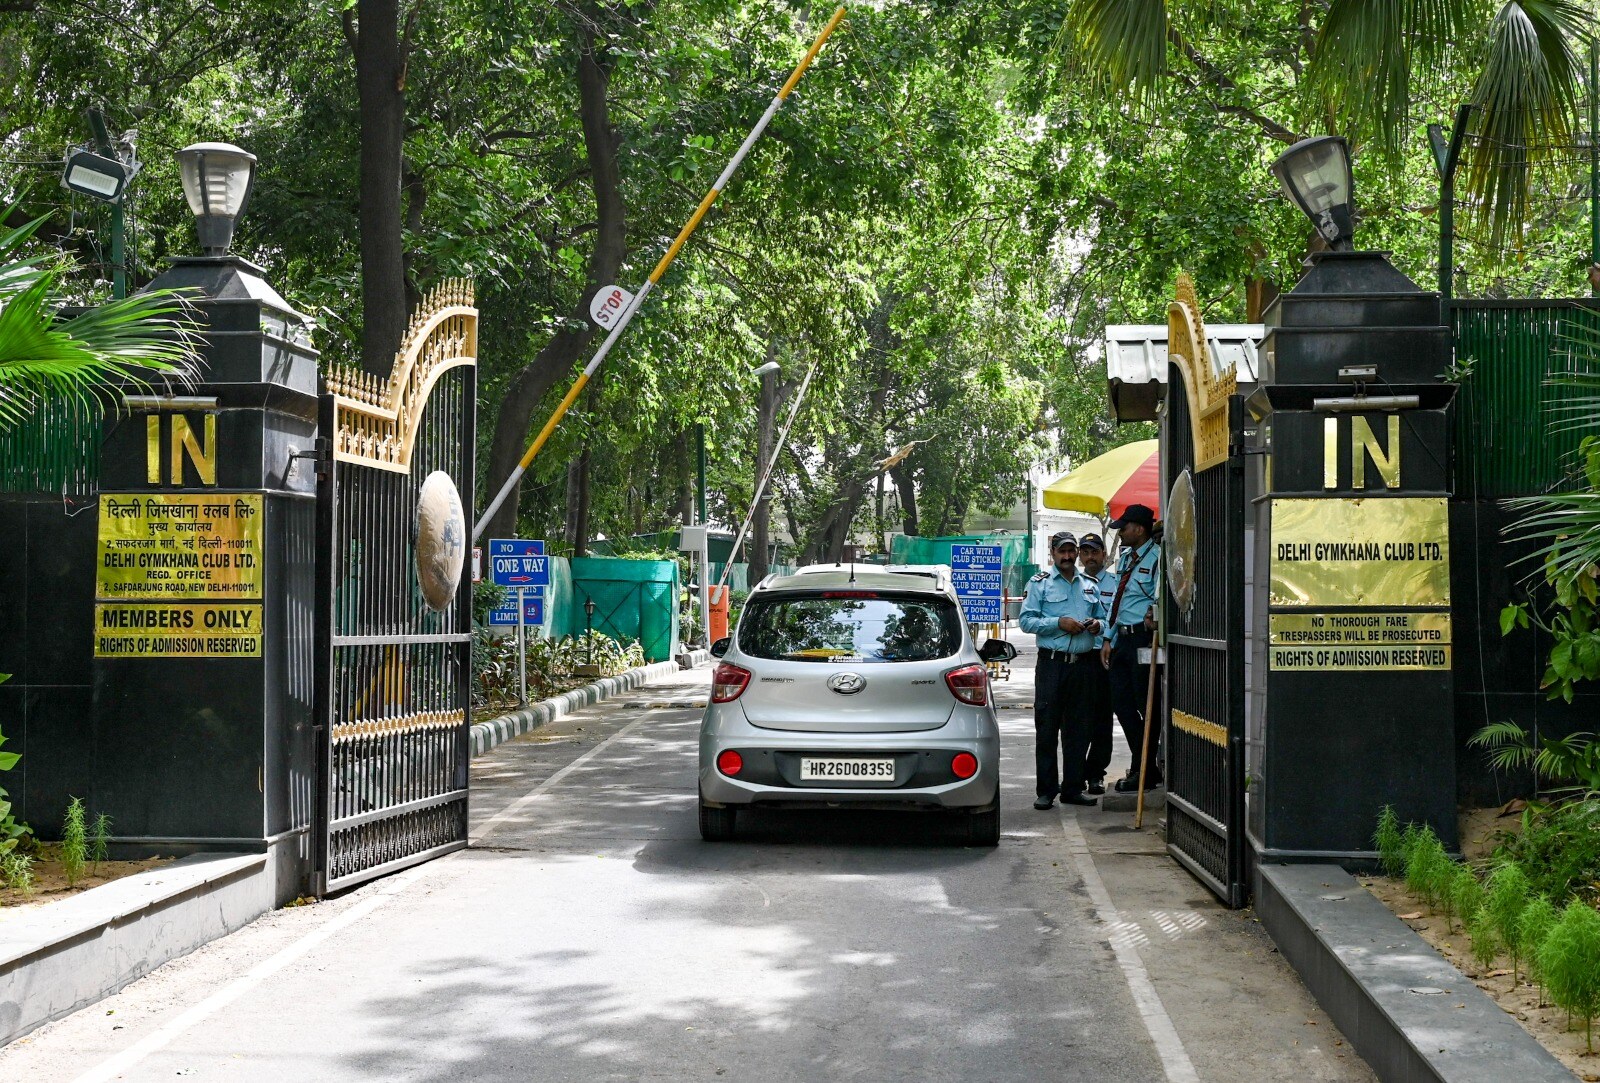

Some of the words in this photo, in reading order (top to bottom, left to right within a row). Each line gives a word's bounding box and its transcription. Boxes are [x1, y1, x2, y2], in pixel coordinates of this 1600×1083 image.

[596, 290, 623, 323] STOP
[147, 414, 216, 484] IN
[1324, 415, 1400, 488] IN
[107, 499, 141, 518] दिल्ली
[146, 499, 198, 519] जिमखाना
[203, 504, 230, 519] क्लब
[148, 522, 168, 536] मुख्य
[175, 519, 212, 532] कार्यालय
[182, 536, 194, 550] नई
[501, 544, 514, 552] NO
[960, 547, 975, 555] CAR
[975, 547, 993, 555] WITH
[1278, 543, 1311, 561] DELHI
[1315, 543, 1381, 561] GYMKHANA
[1384, 543, 1414, 561] CLUB
[1418, 543, 1443, 561] LTD.
[104, 553, 135, 568] DELHI
[139, 553, 198, 568] GYMKHANA
[202, 553, 230, 568] CLUB
[234, 553, 256, 568] LTD.
[496, 559, 519, 573] ONE
[522, 559, 545, 573] WAY
[952, 555, 969, 563] CLUB
[971, 556, 1001, 564] STICKER
[146, 571, 172, 580] REGD.
[177, 571, 211, 580] OFFICE
[952, 573, 966, 581] CAR
[968, 573, 1000, 582] WITHOUT
[114, 583, 163, 592] SAFDARJUNG
[166, 583, 187, 592] ROAD,
[189, 583, 205, 592] NEW
[970, 582, 1000, 590] STICKER
[103, 610, 194, 628] MEMBERS
[204, 610, 252, 628] ONLY
[1311, 617, 1324, 627] NO
[1330, 617, 1380, 627] THOROUGH
[1386, 616, 1407, 626] FARE
[1280, 631, 1342, 641] TRESPASSERS
[1344, 631, 1365, 641] WILL
[1368, 631, 1379, 640] BE
[1382, 630, 1441, 640] PROSECUTED
[100, 638, 135, 652] RIGHTS
[137, 638, 149, 652] OF
[152, 638, 204, 652] ADMISSION
[207, 638, 256, 652] RESERVED
[1276, 651, 1314, 666] RIGHTS
[1317, 651, 1329, 666] OF
[1332, 651, 1389, 666] ADMISSION
[1392, 650, 1445, 666] RESERVED
[810, 762, 893, 776] HR26DQ8359
